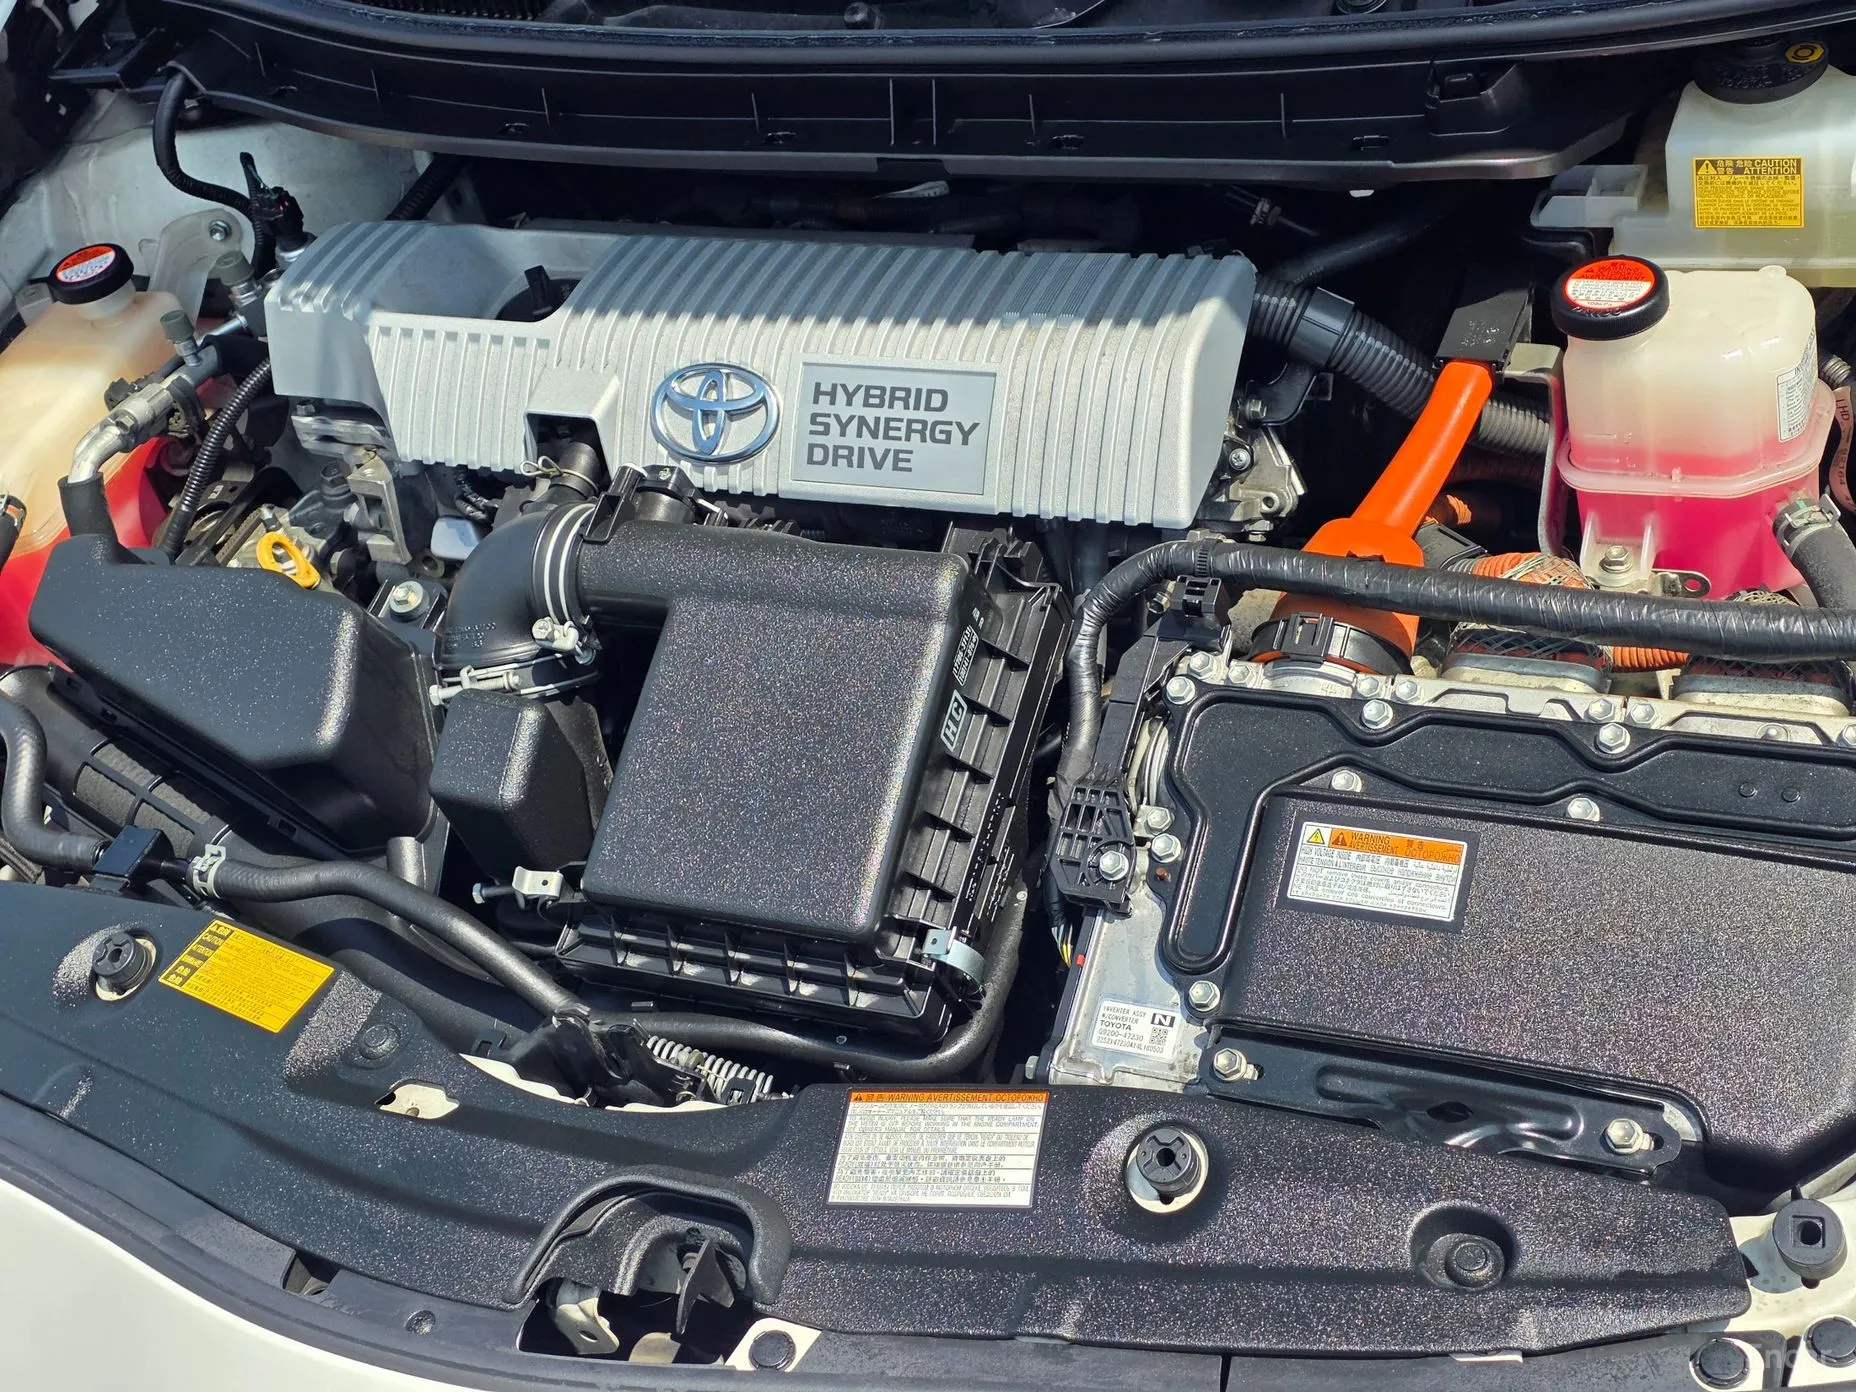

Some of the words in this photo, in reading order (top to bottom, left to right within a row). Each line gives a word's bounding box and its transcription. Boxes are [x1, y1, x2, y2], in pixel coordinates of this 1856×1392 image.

[1755, 159, 1797, 167] CAUTION
[1744, 167, 1797, 175] ATTENTION
[813, 381, 949, 413] HYBRID
[809, 412, 981, 446] SYNERGY
[806, 443, 914, 473] DRIVE
[1350, 832, 1390, 844] WARNING
[1348, 840, 1398, 854] AVERTISSEMENT
[1103, 1006, 1130, 1014] INVERTER
[1100, 1019, 1132, 1031] TOYOTA
[1099, 1028, 1144, 1041] G9200-47230
